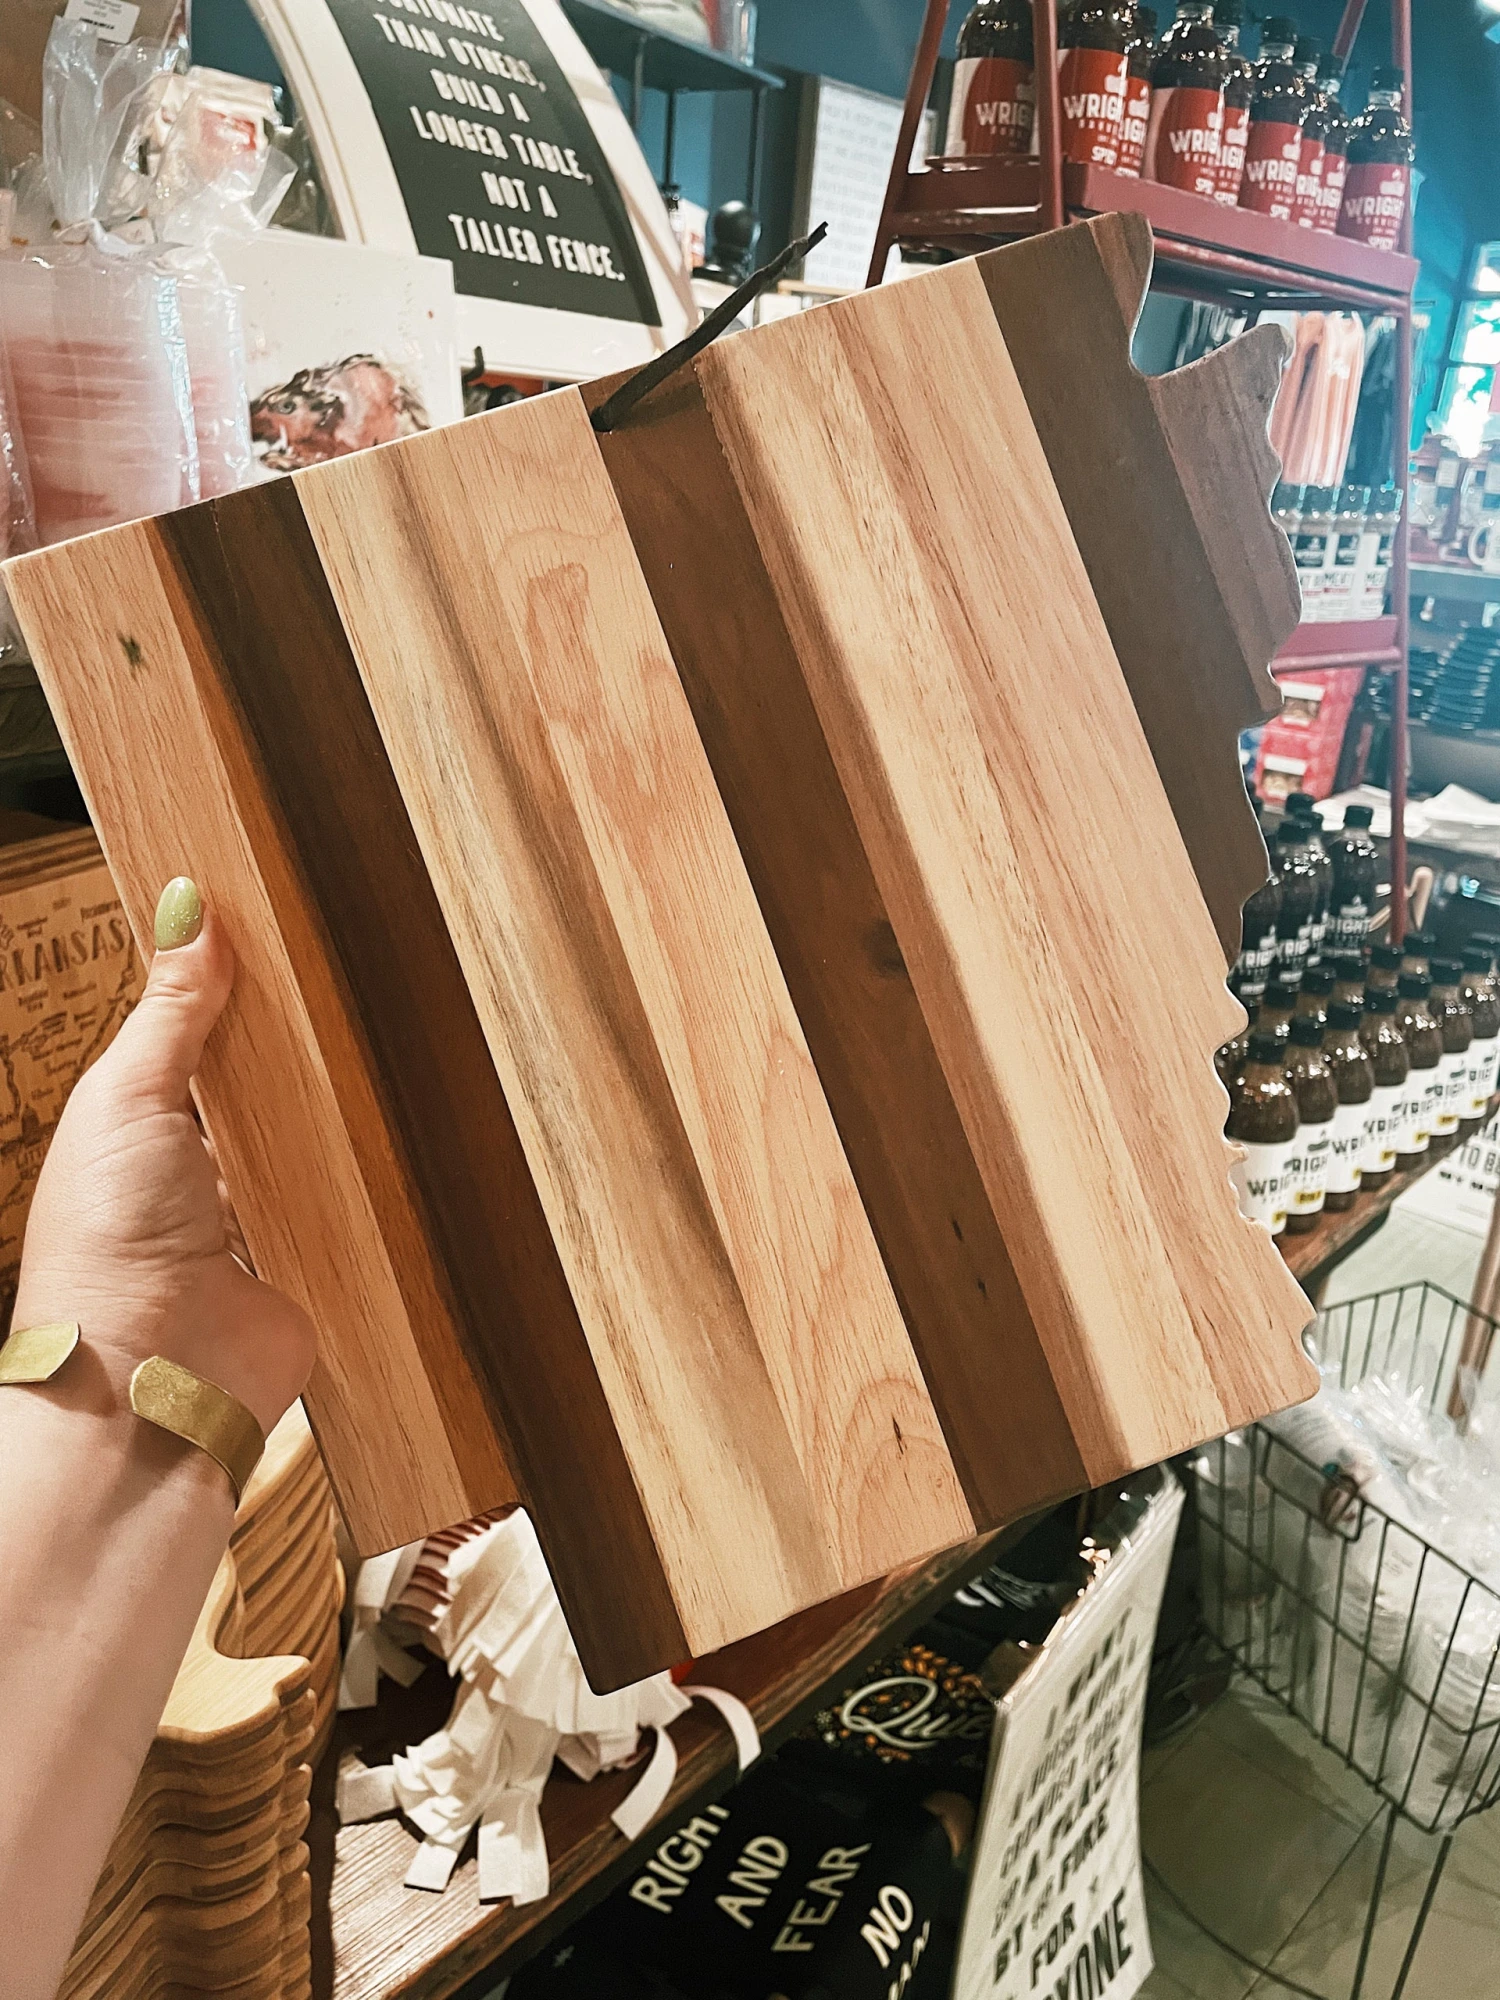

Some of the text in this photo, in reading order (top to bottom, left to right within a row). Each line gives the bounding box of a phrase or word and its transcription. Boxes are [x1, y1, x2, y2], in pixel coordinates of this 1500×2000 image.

[373, 13, 447, 59] THAN
[430, 68, 530, 123] BUILD A
[409, 105, 593, 185] LONGER TABLE,
[481, 170, 558, 219] NOT A
[448, 213, 625, 282] TALLER FENCE.
[714, 1835, 790, 1930] AND
[770, 1842, 873, 1953] FEAR
[860, 1884, 914, 1969] NO
[993, 1913, 1028, 1985] BY
[1029, 1901, 1077, 1991] FOR
